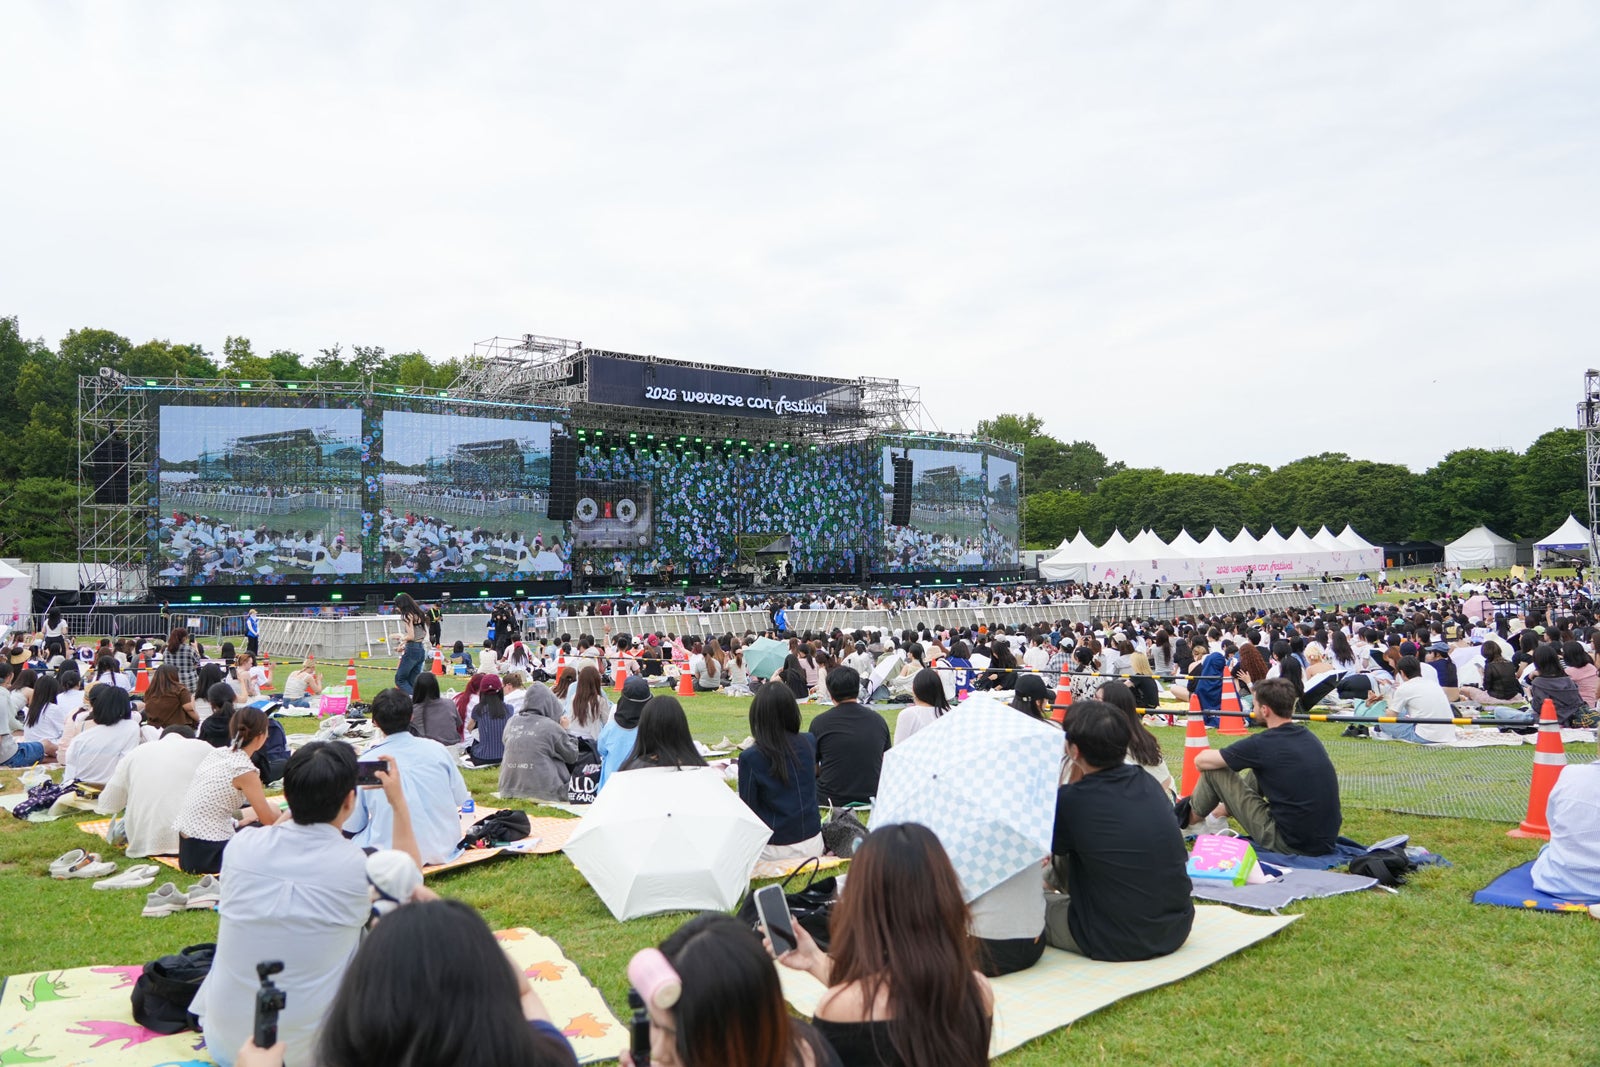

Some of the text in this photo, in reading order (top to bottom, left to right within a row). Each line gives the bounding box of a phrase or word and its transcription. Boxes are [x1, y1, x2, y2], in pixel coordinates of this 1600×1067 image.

[645, 386, 828, 415] 2026 weverse con festival
[1216, 560, 1293, 574] 2026 wevee con festival
